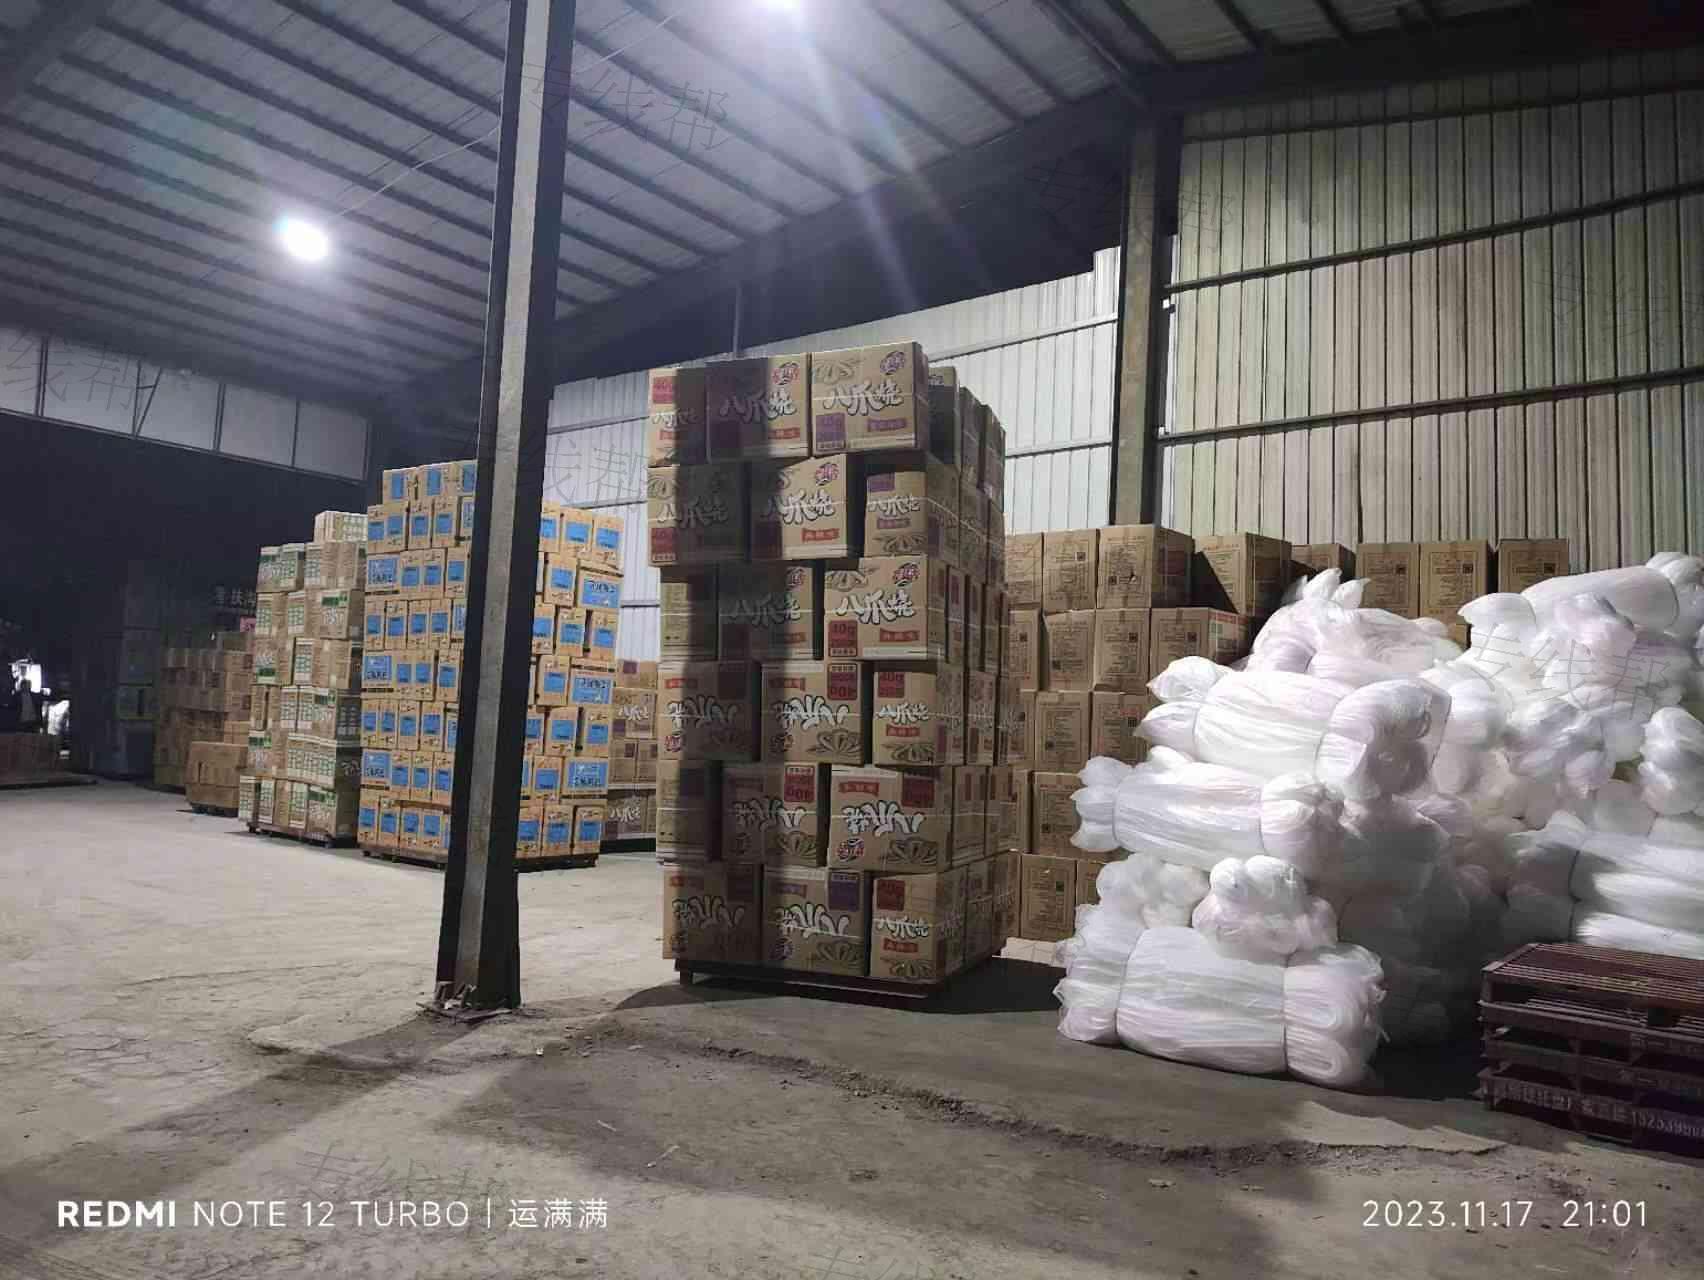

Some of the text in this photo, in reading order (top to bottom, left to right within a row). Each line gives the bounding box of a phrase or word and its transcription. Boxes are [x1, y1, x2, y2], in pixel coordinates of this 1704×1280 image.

[823, 377, 904, 416] 八爪烧
[768, 490, 836, 524] 八爪烧
[836, 589, 915, 625] 八爪烧
